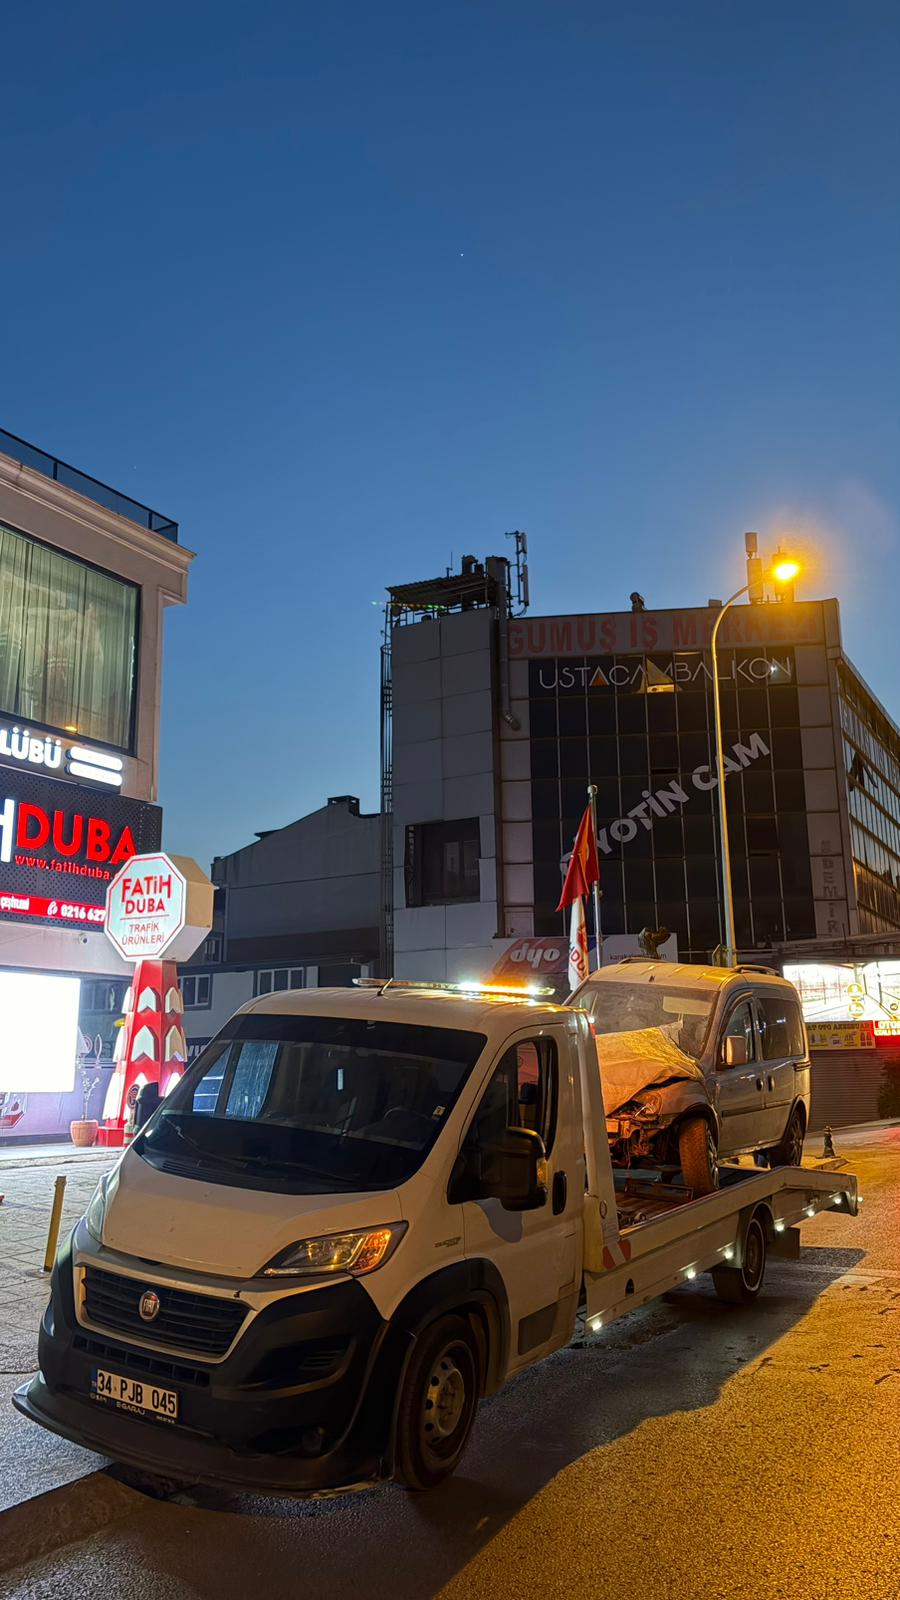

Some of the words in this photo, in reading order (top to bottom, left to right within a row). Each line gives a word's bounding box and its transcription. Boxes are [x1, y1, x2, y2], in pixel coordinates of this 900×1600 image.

[122, 874, 172, 903] FATİH
[125, 898, 166, 915] DUBA
[129, 921, 160, 932] TRAFİK
[121, 932, 165, 946] ÜRÜNLERİ
[510, 942, 561, 969] dyo
[98, 1372, 112, 1394] 34
[120, 1378, 143, 1404] PJB
[152, 1389, 176, 1414] 045
